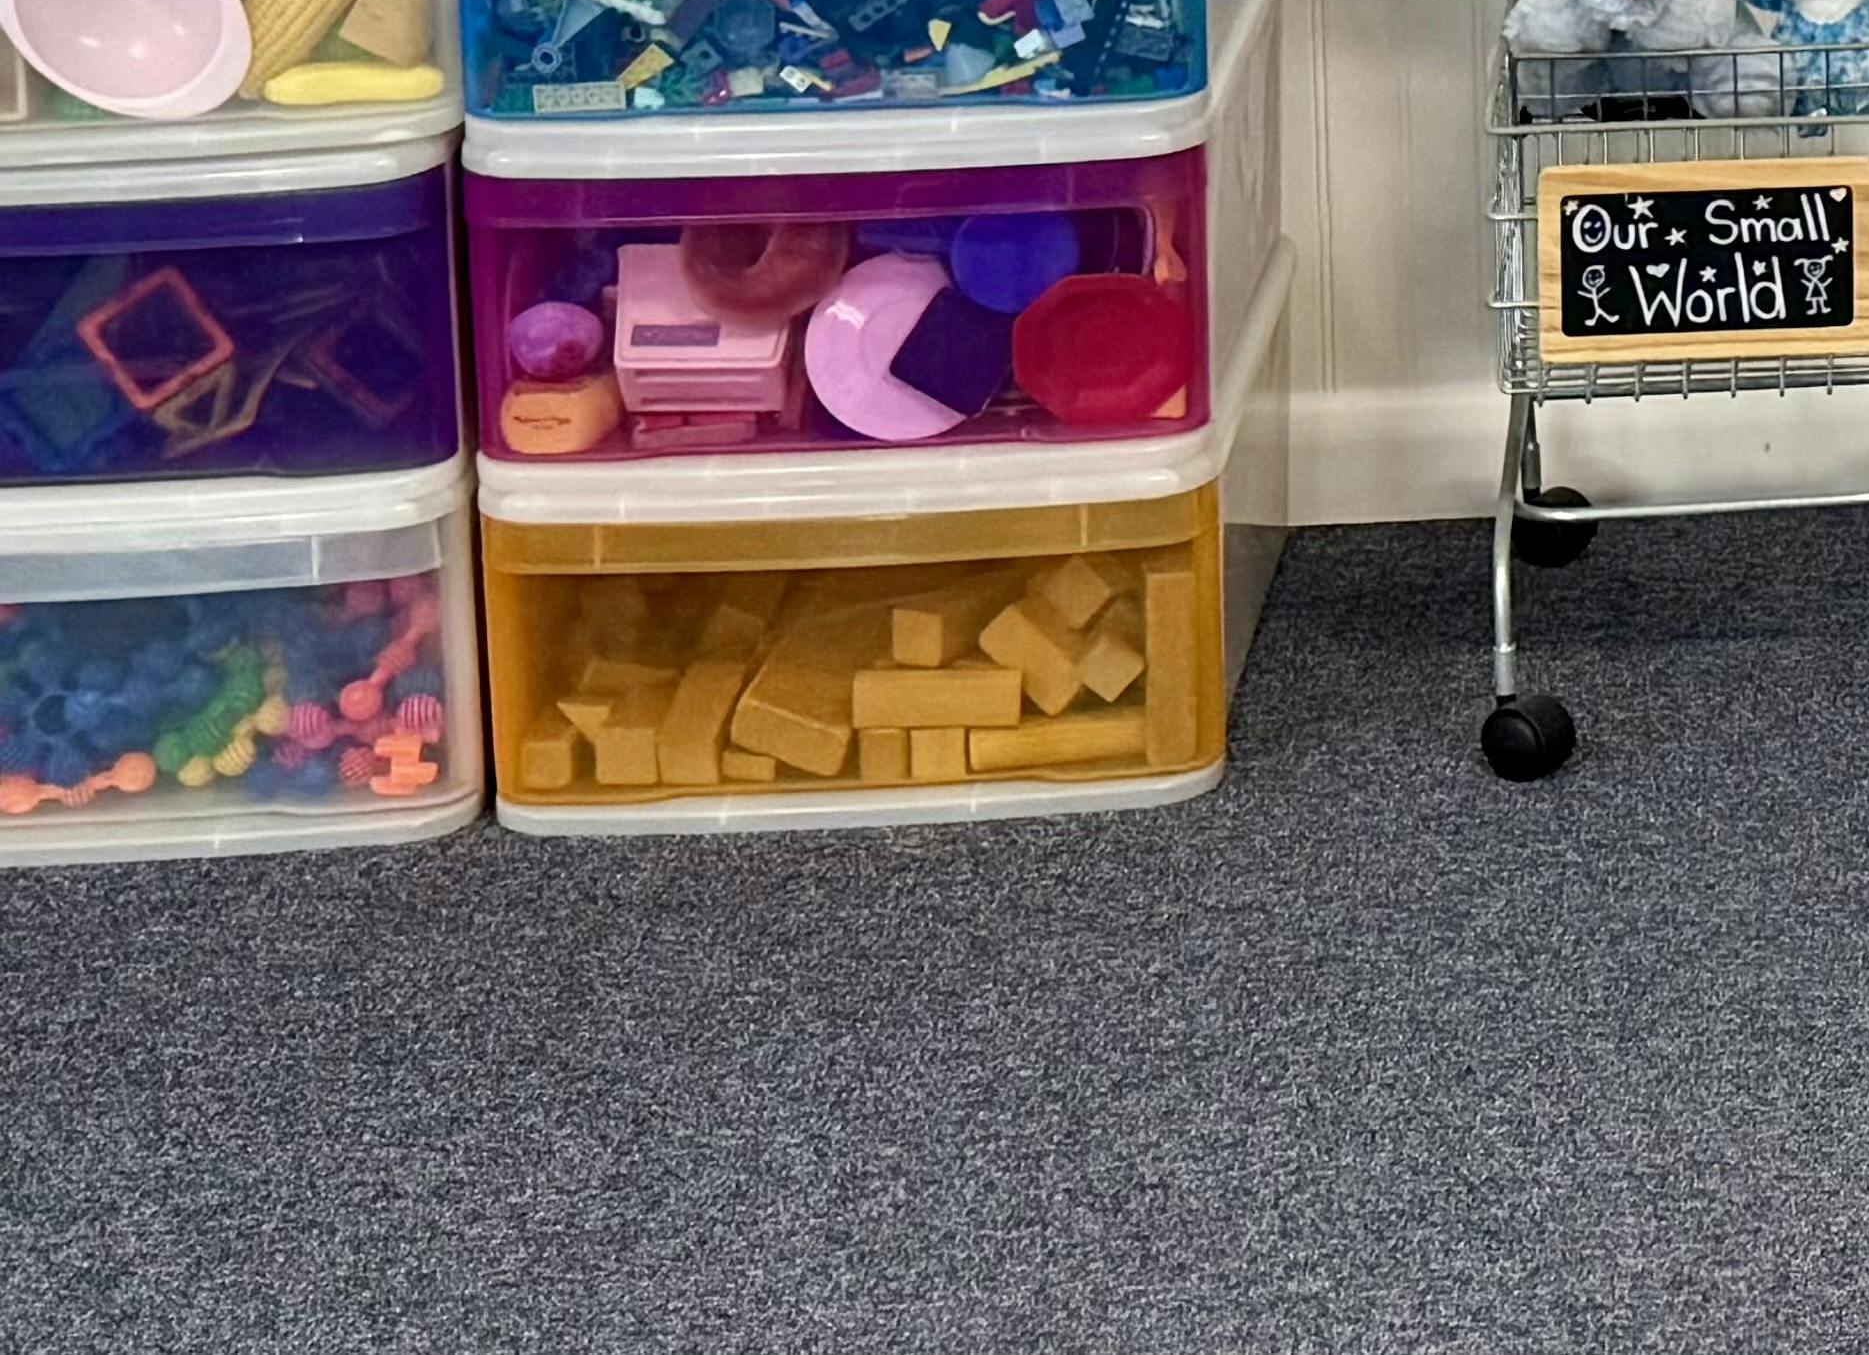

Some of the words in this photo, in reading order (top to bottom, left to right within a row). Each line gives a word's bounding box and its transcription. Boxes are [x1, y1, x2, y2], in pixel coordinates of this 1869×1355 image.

[1572, 203, 1658, 253] Our
[1704, 193, 1830, 245] Small
[1629, 251, 1787, 327] World
